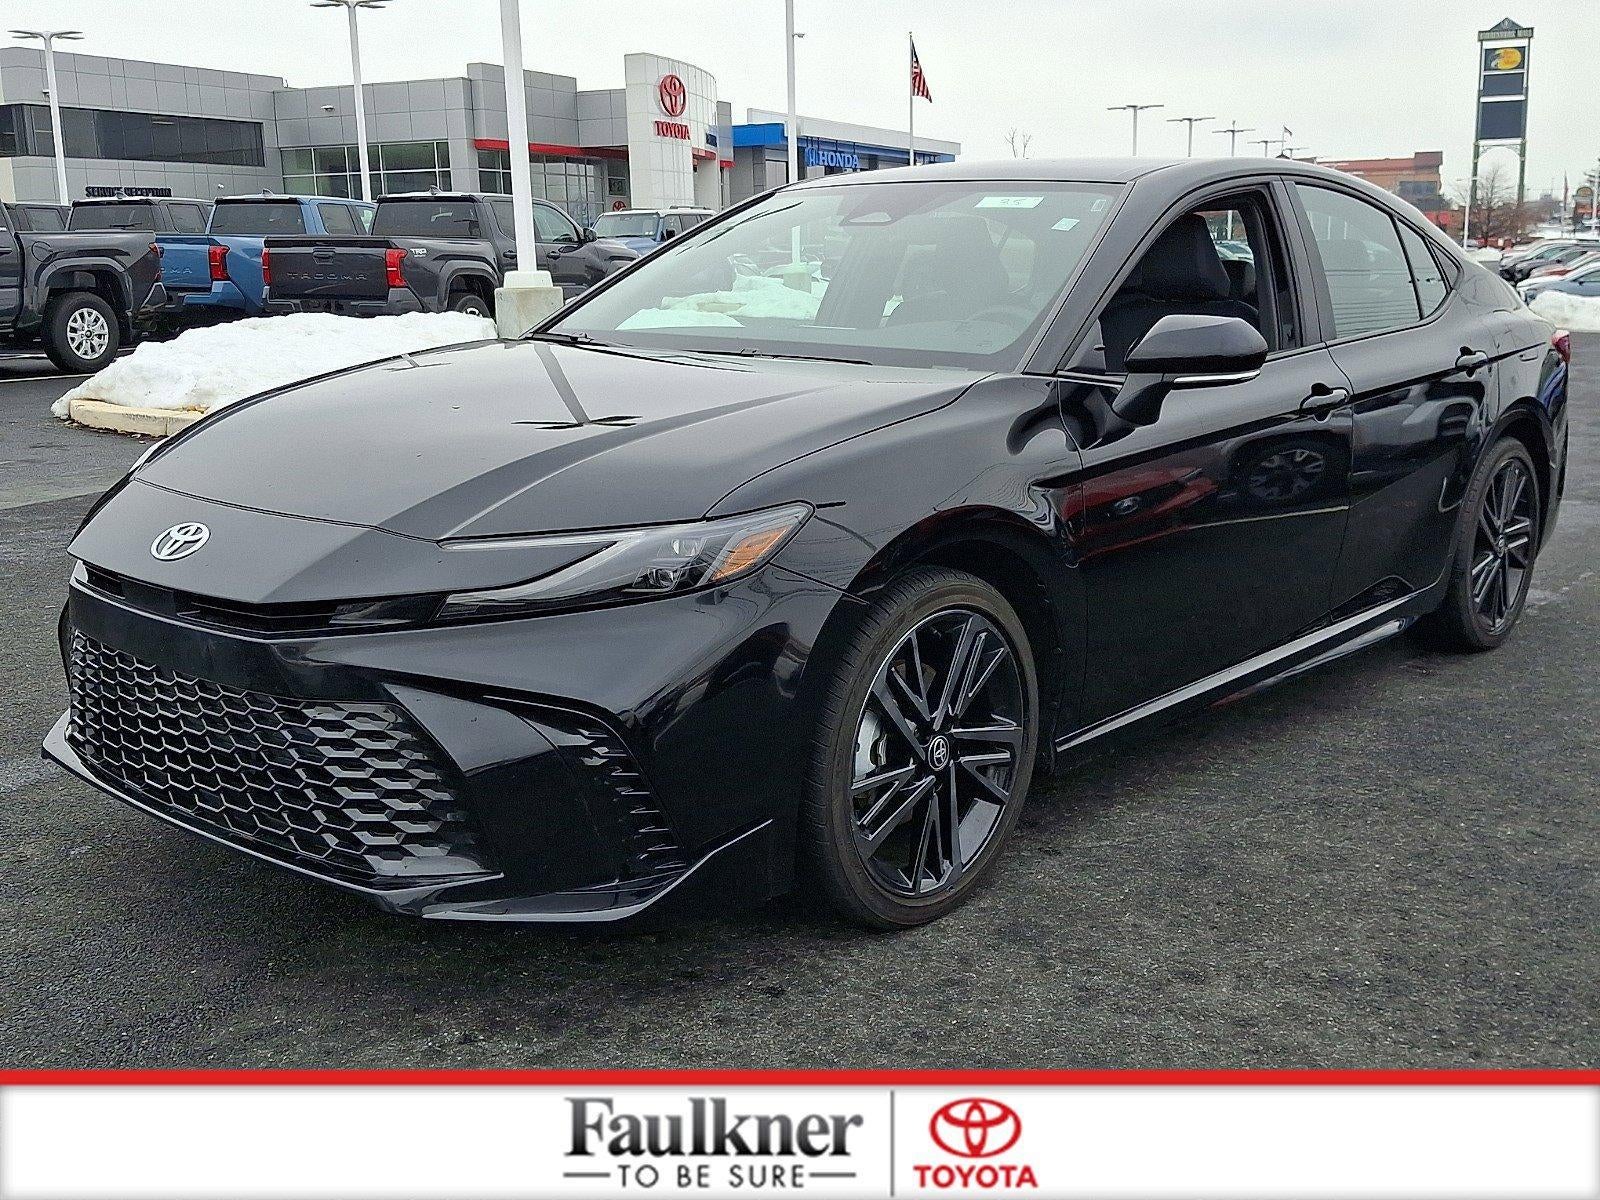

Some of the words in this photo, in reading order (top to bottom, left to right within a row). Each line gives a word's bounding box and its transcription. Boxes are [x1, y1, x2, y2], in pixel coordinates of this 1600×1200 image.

[655, 120, 691, 140] TOYOTA
[818, 150, 860, 168] HONDA
[286, 272, 367, 280] TACOMA
